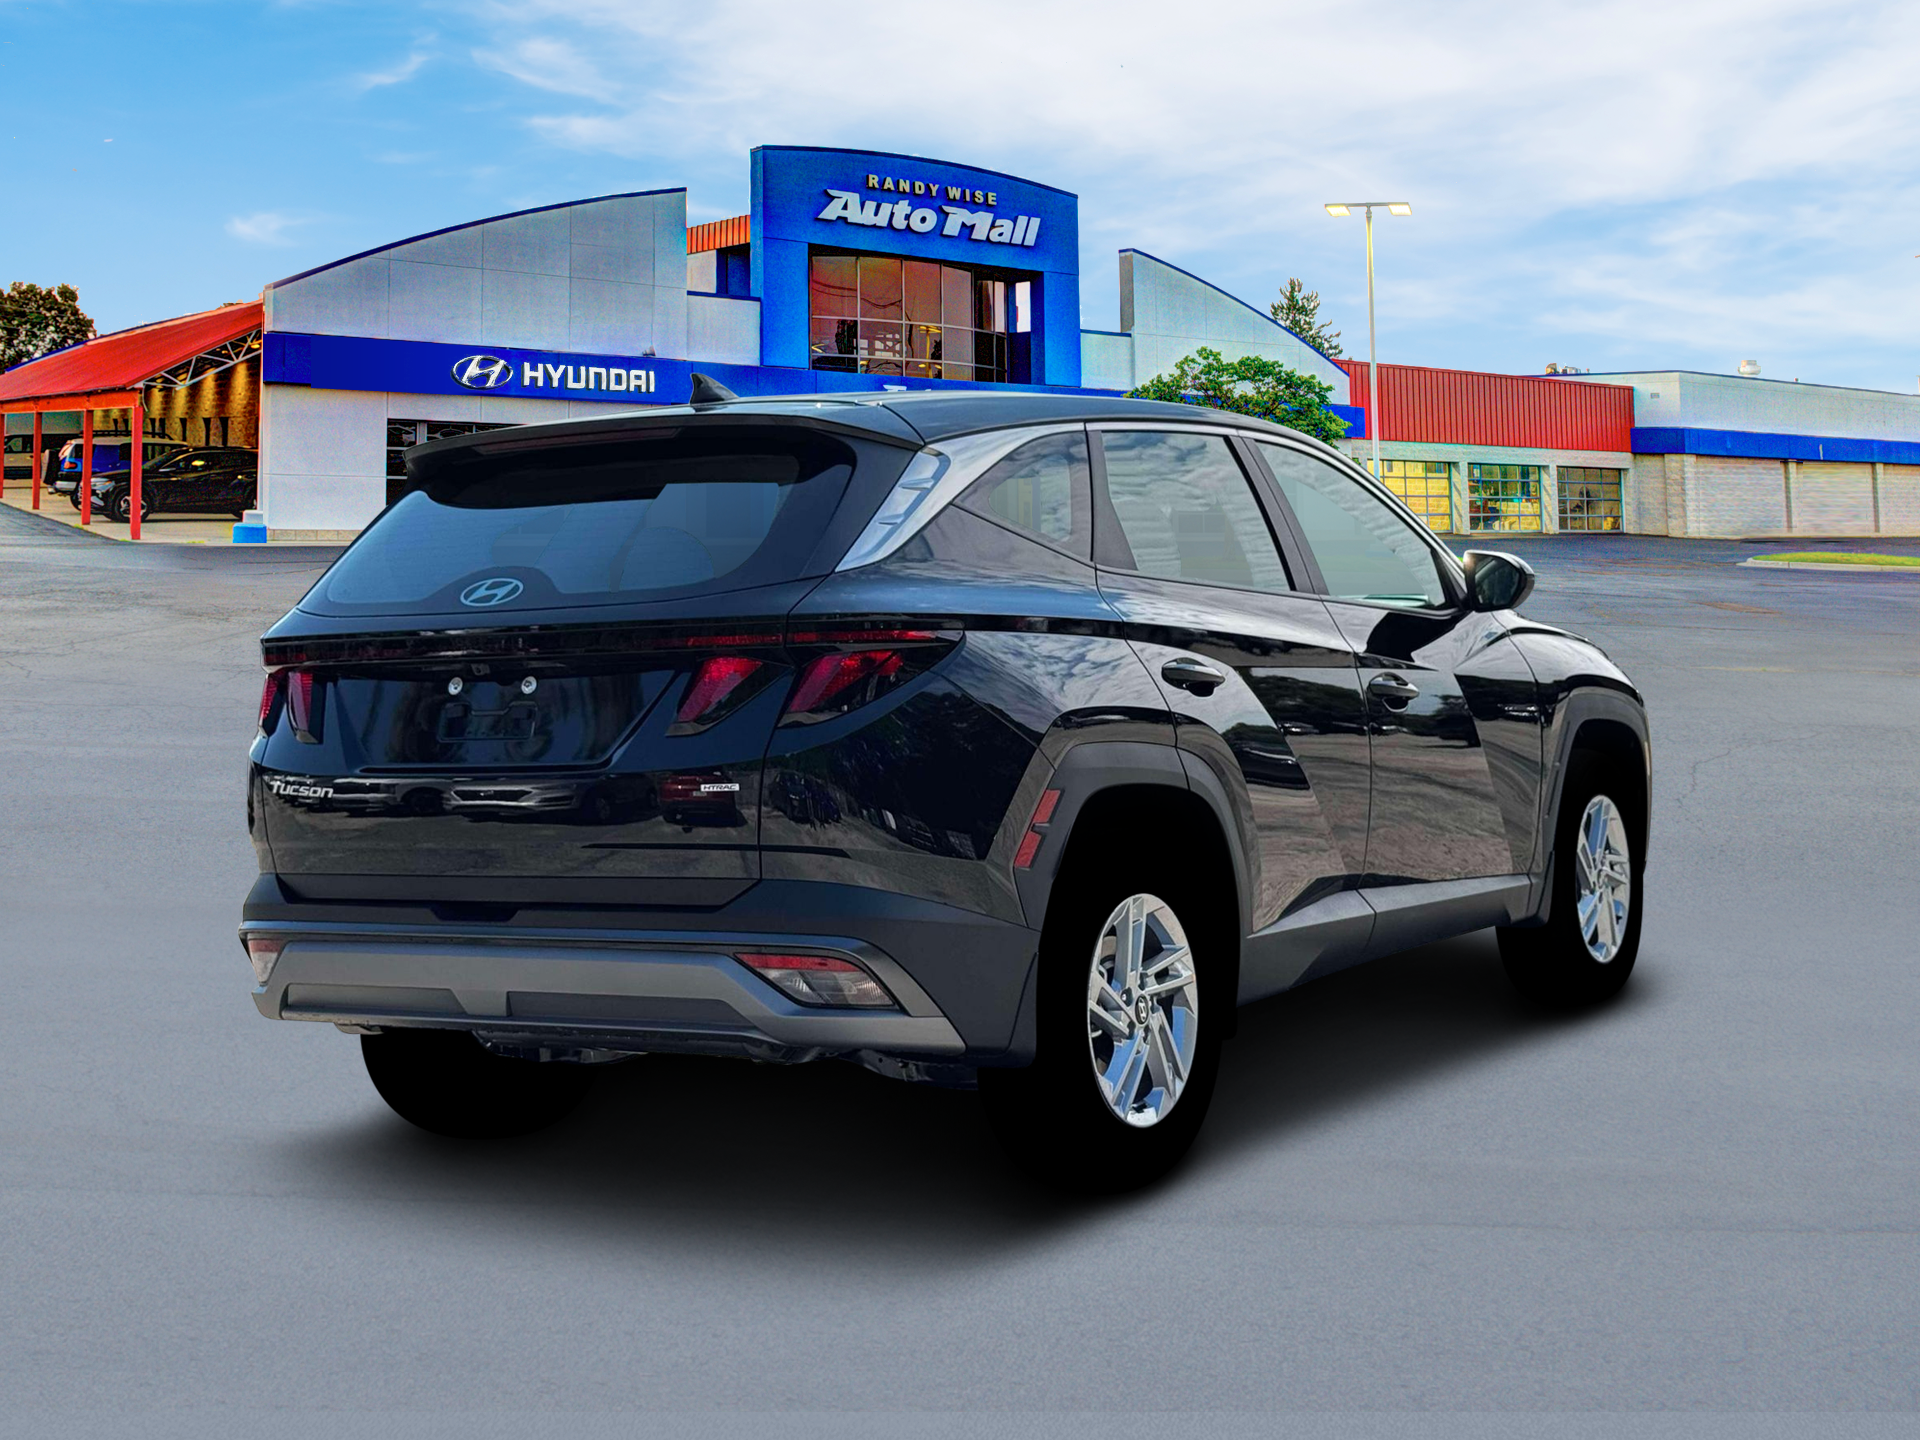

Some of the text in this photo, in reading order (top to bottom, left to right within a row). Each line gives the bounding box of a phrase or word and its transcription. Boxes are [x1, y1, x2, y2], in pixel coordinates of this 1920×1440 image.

[867, 174, 997, 206] RANDY WISE
[815, 188, 1041, 247] Auto Mall
[521, 362, 655, 393] HYUNDAI
